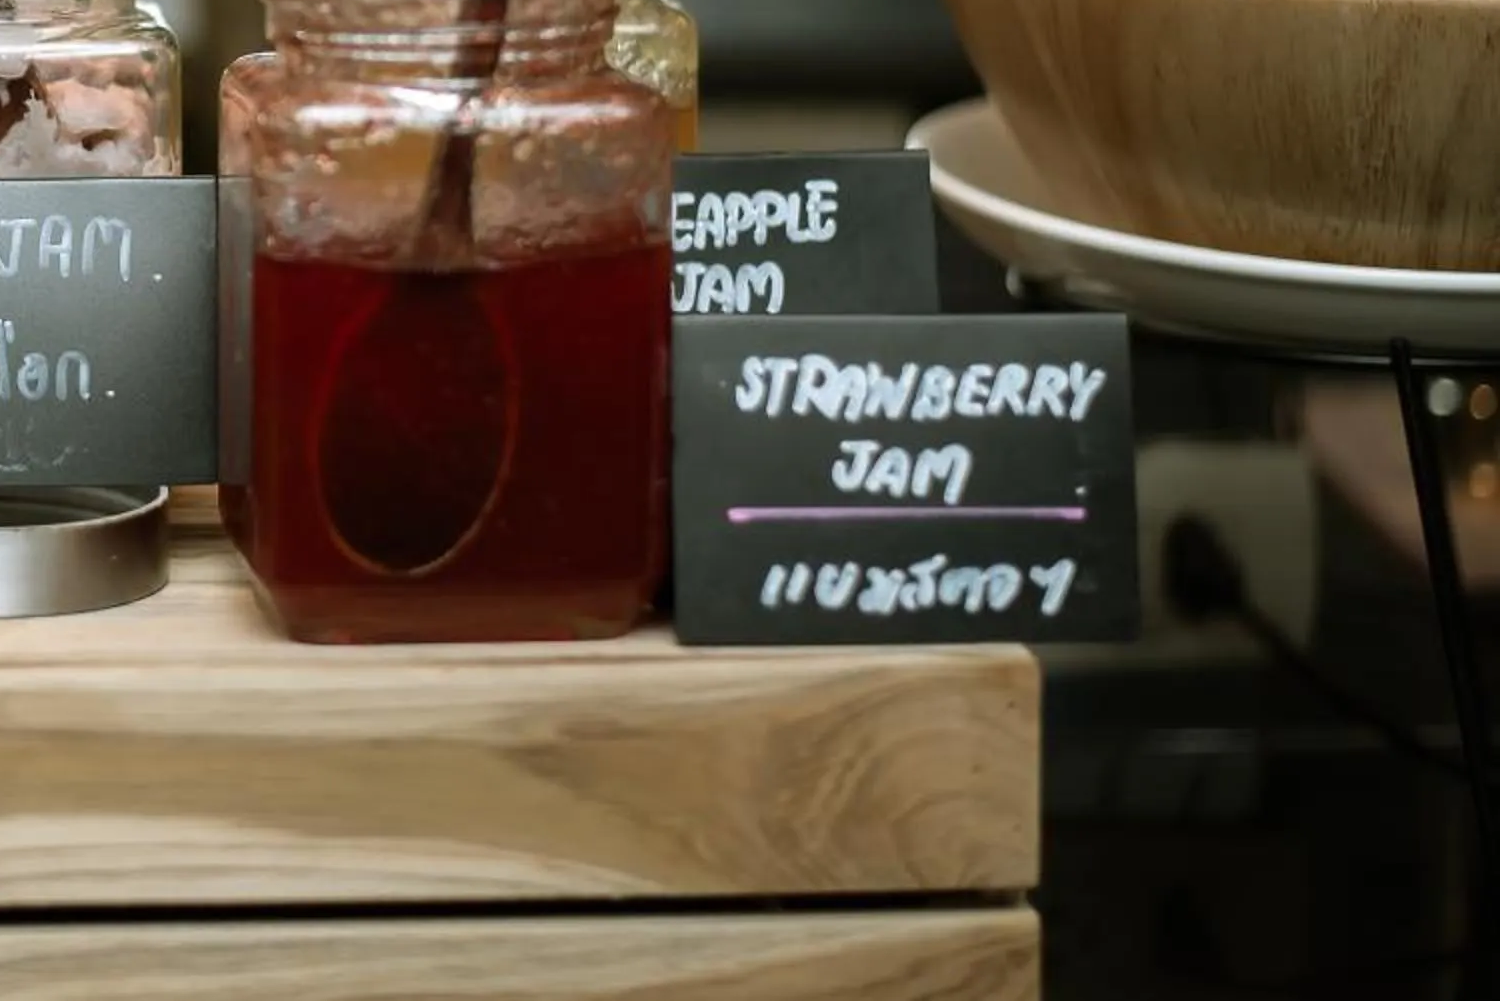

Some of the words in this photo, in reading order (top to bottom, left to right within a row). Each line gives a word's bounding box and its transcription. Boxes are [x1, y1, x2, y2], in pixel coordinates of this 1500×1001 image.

[671, 261, 785, 314] JAM
[735, 354, 1107, 422] STRAWBERRY
[832, 440, 973, 505] JAM
